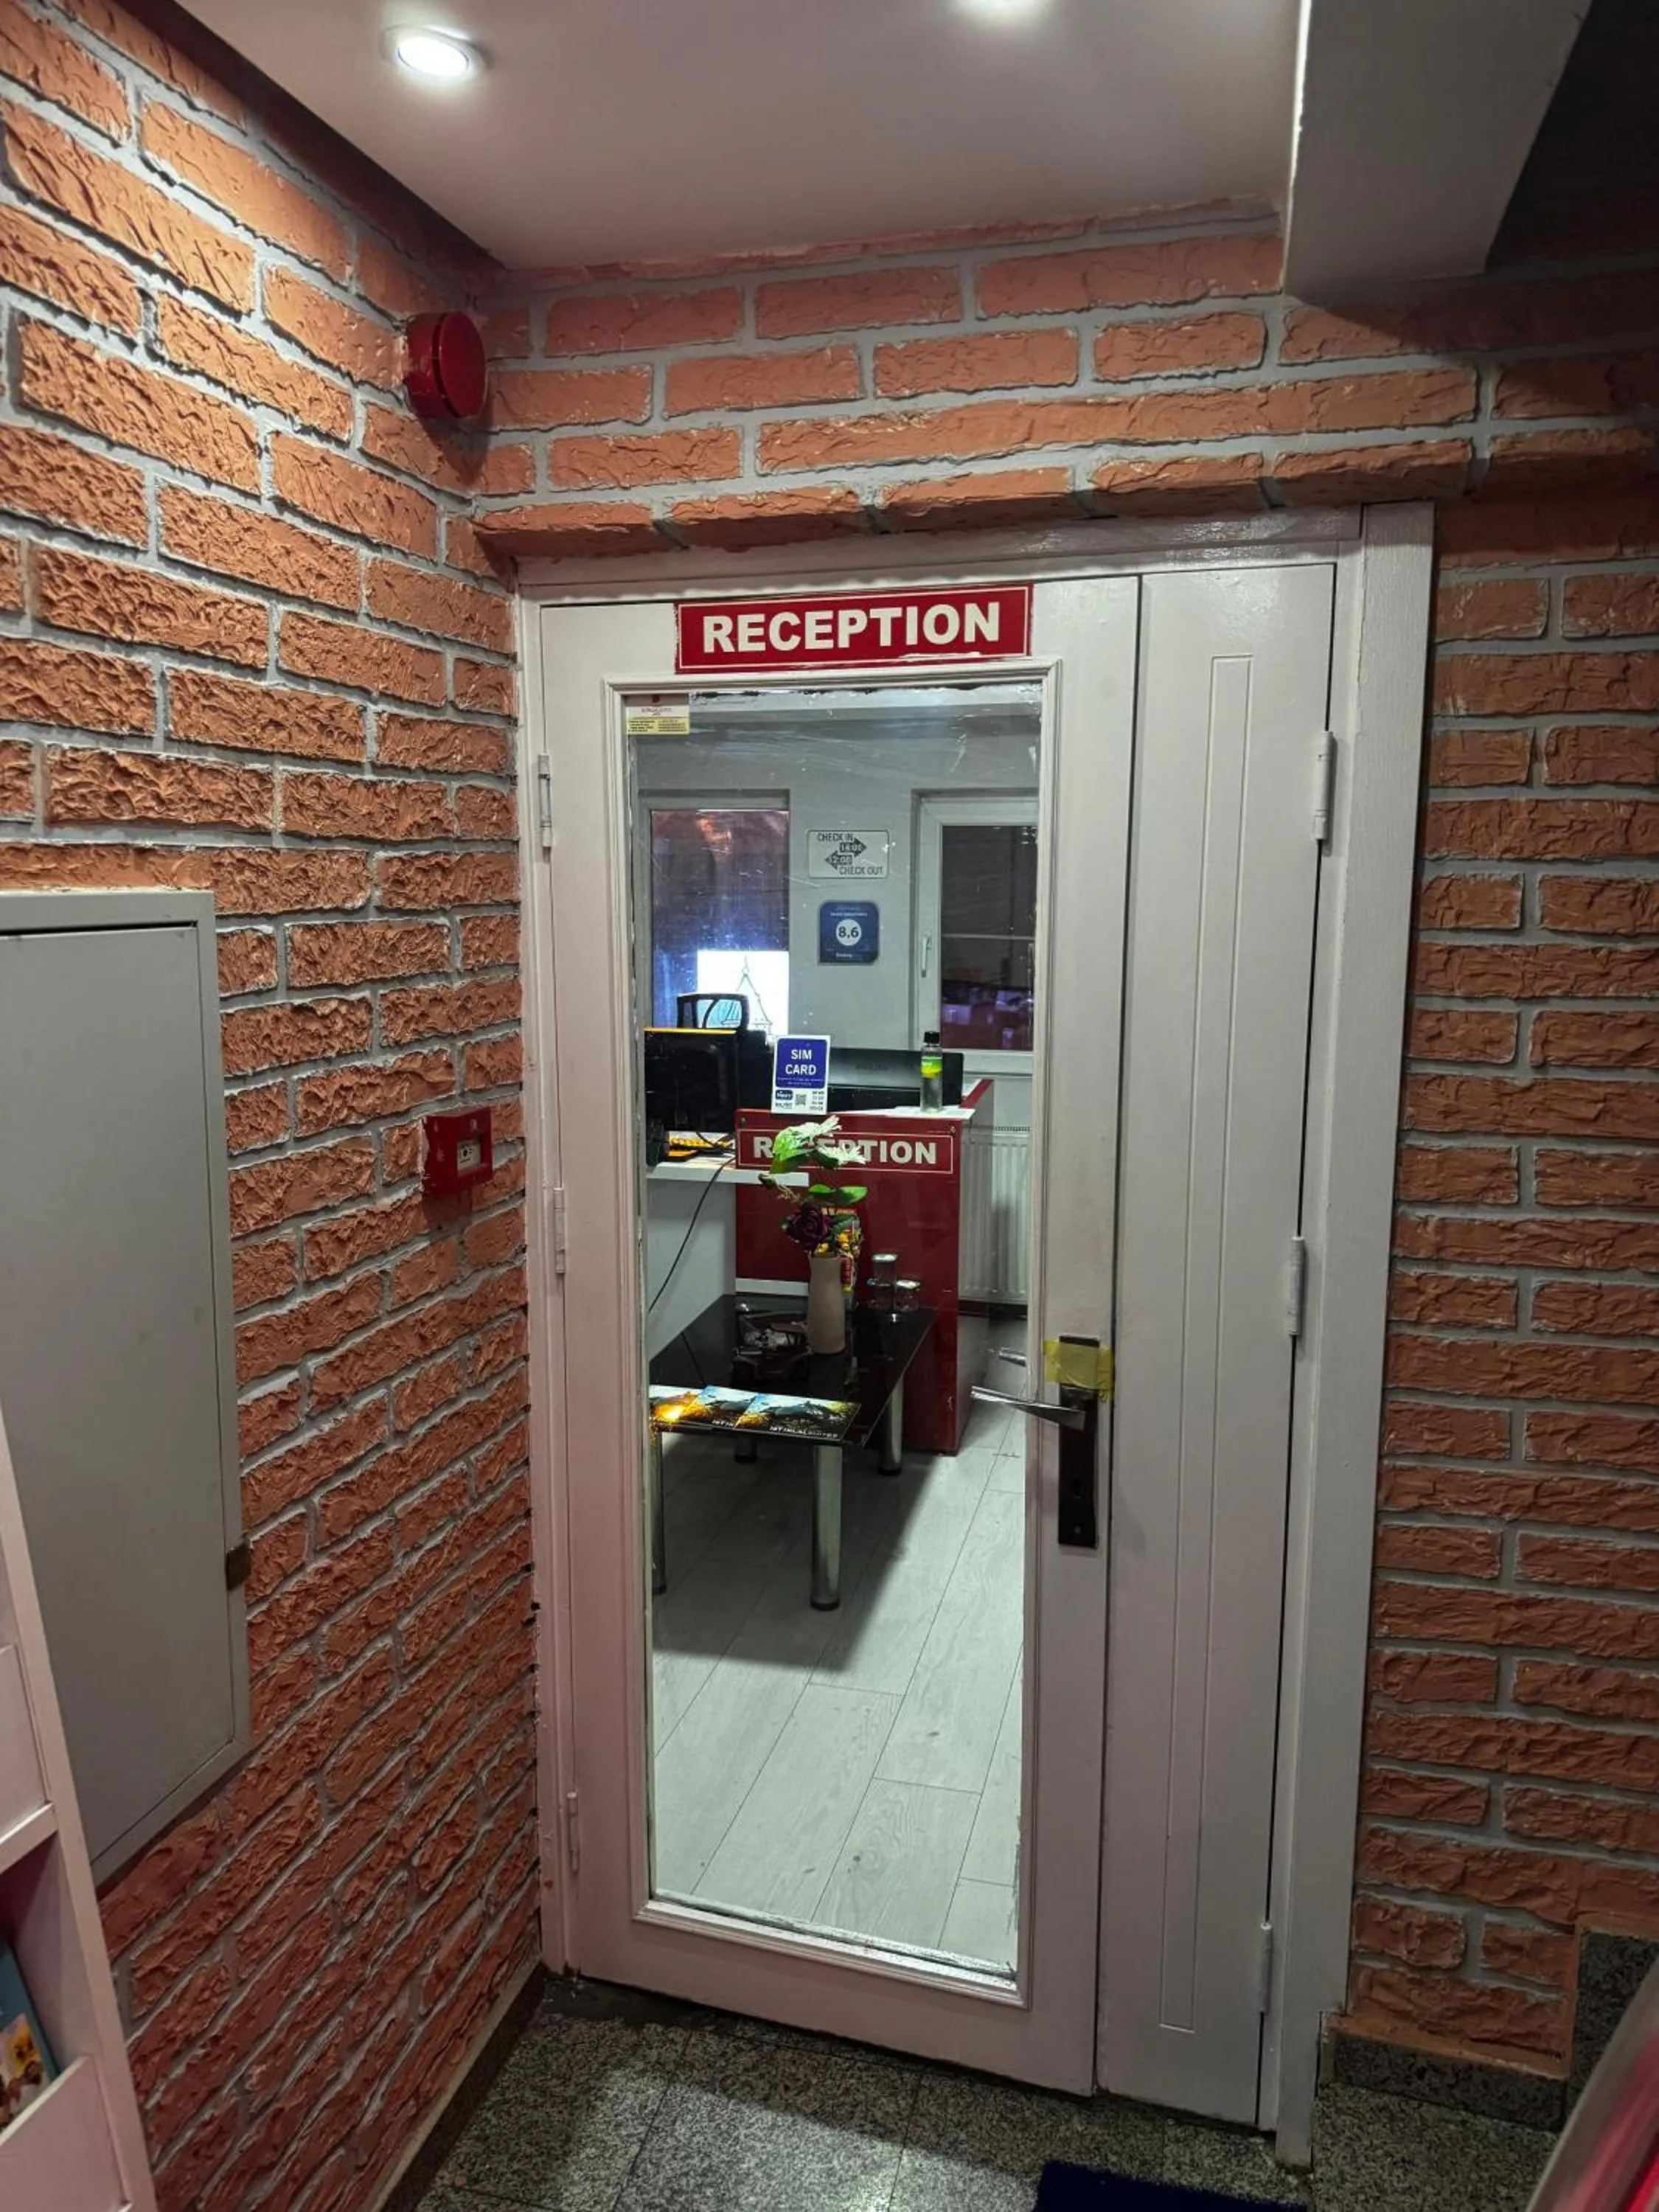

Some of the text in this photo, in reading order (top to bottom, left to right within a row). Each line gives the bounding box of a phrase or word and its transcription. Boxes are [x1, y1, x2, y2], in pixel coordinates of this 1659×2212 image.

[703, 601, 1000, 654] RECEPTION
[817, 832, 853, 841] CHECK IN
[838, 866, 883, 875] CHECK OUT
[791, 1049, 812, 1060] SIM
[785, 1064, 816, 1075] CARD
